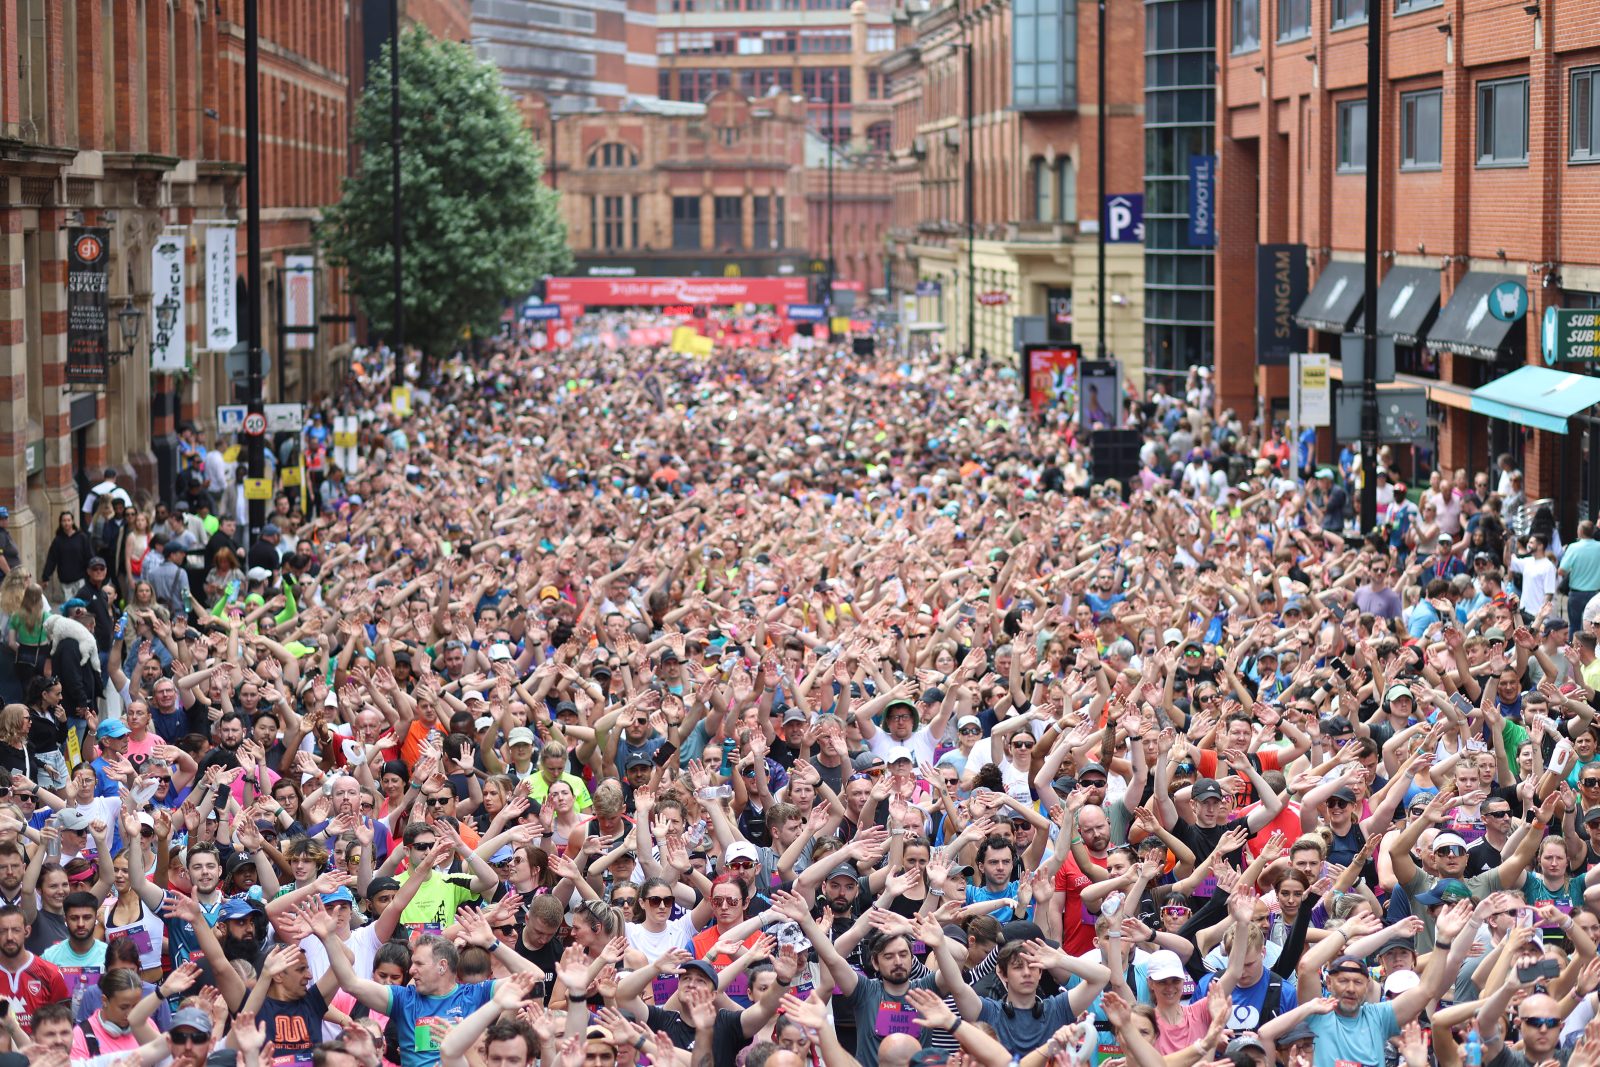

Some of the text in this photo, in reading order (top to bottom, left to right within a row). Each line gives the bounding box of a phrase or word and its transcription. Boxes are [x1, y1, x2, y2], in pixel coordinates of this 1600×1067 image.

[1195, 160, 1209, 234] NOVOTEL
[69, 276, 107, 284] OFFICE
[69, 284, 107, 292] SPACE
[1275, 251, 1291, 338] SANGAM
[248, 418, 263, 429] 20
[890, 1014, 908, 1023] MARK
